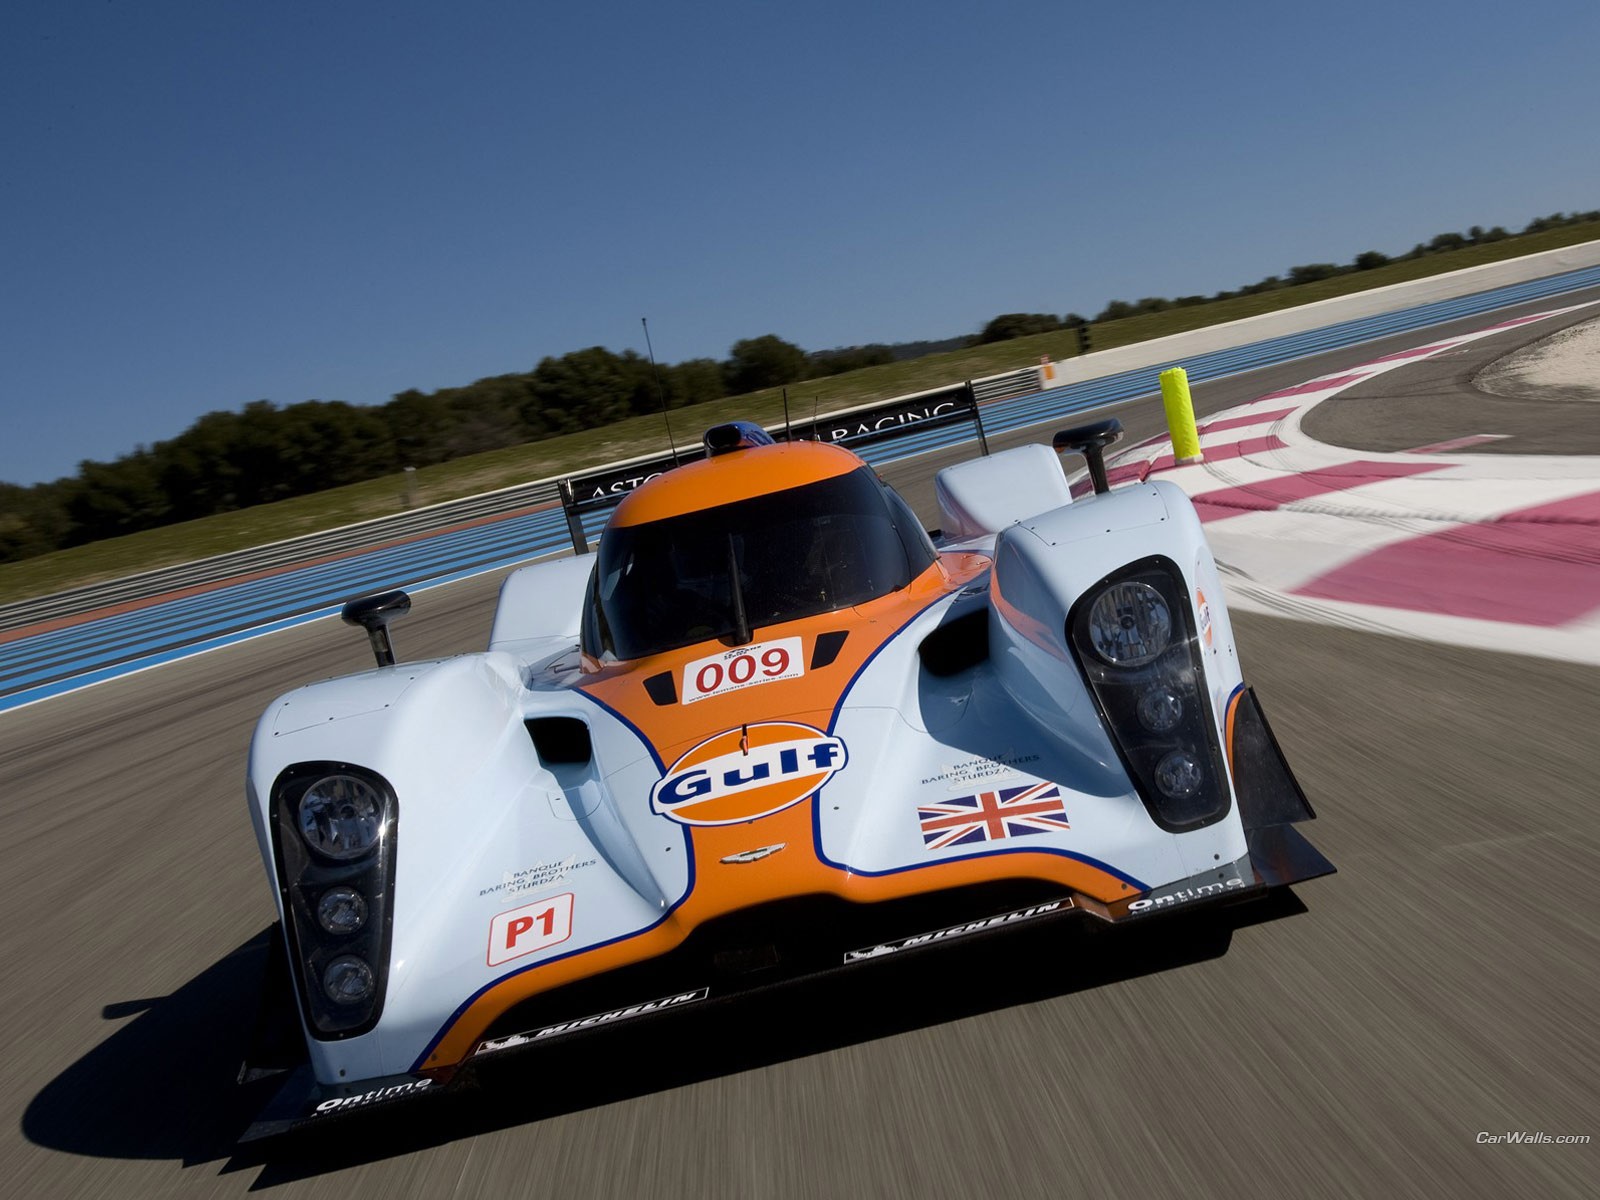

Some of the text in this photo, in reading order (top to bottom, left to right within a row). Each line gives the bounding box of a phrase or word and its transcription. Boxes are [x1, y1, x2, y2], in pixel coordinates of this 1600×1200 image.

[592, 472, 663, 499] AST
[695, 647, 790, 693] 009
[657, 743, 839, 805] Gulf
[921, 754, 1041, 785] BARING BROTHERS
[953, 754, 1003, 771] BANQUE
[953, 767, 1011, 783] STURDZA
[479, 859, 597, 896] BARING BROTHERS
[509, 874, 565, 893] STURDZA
[513, 861, 565, 878] BANQUE
[505, 907, 555, 950] P1
[902, 902, 1060, 947] MICHELIN
[535, 992, 697, 1038] MICHELIN
